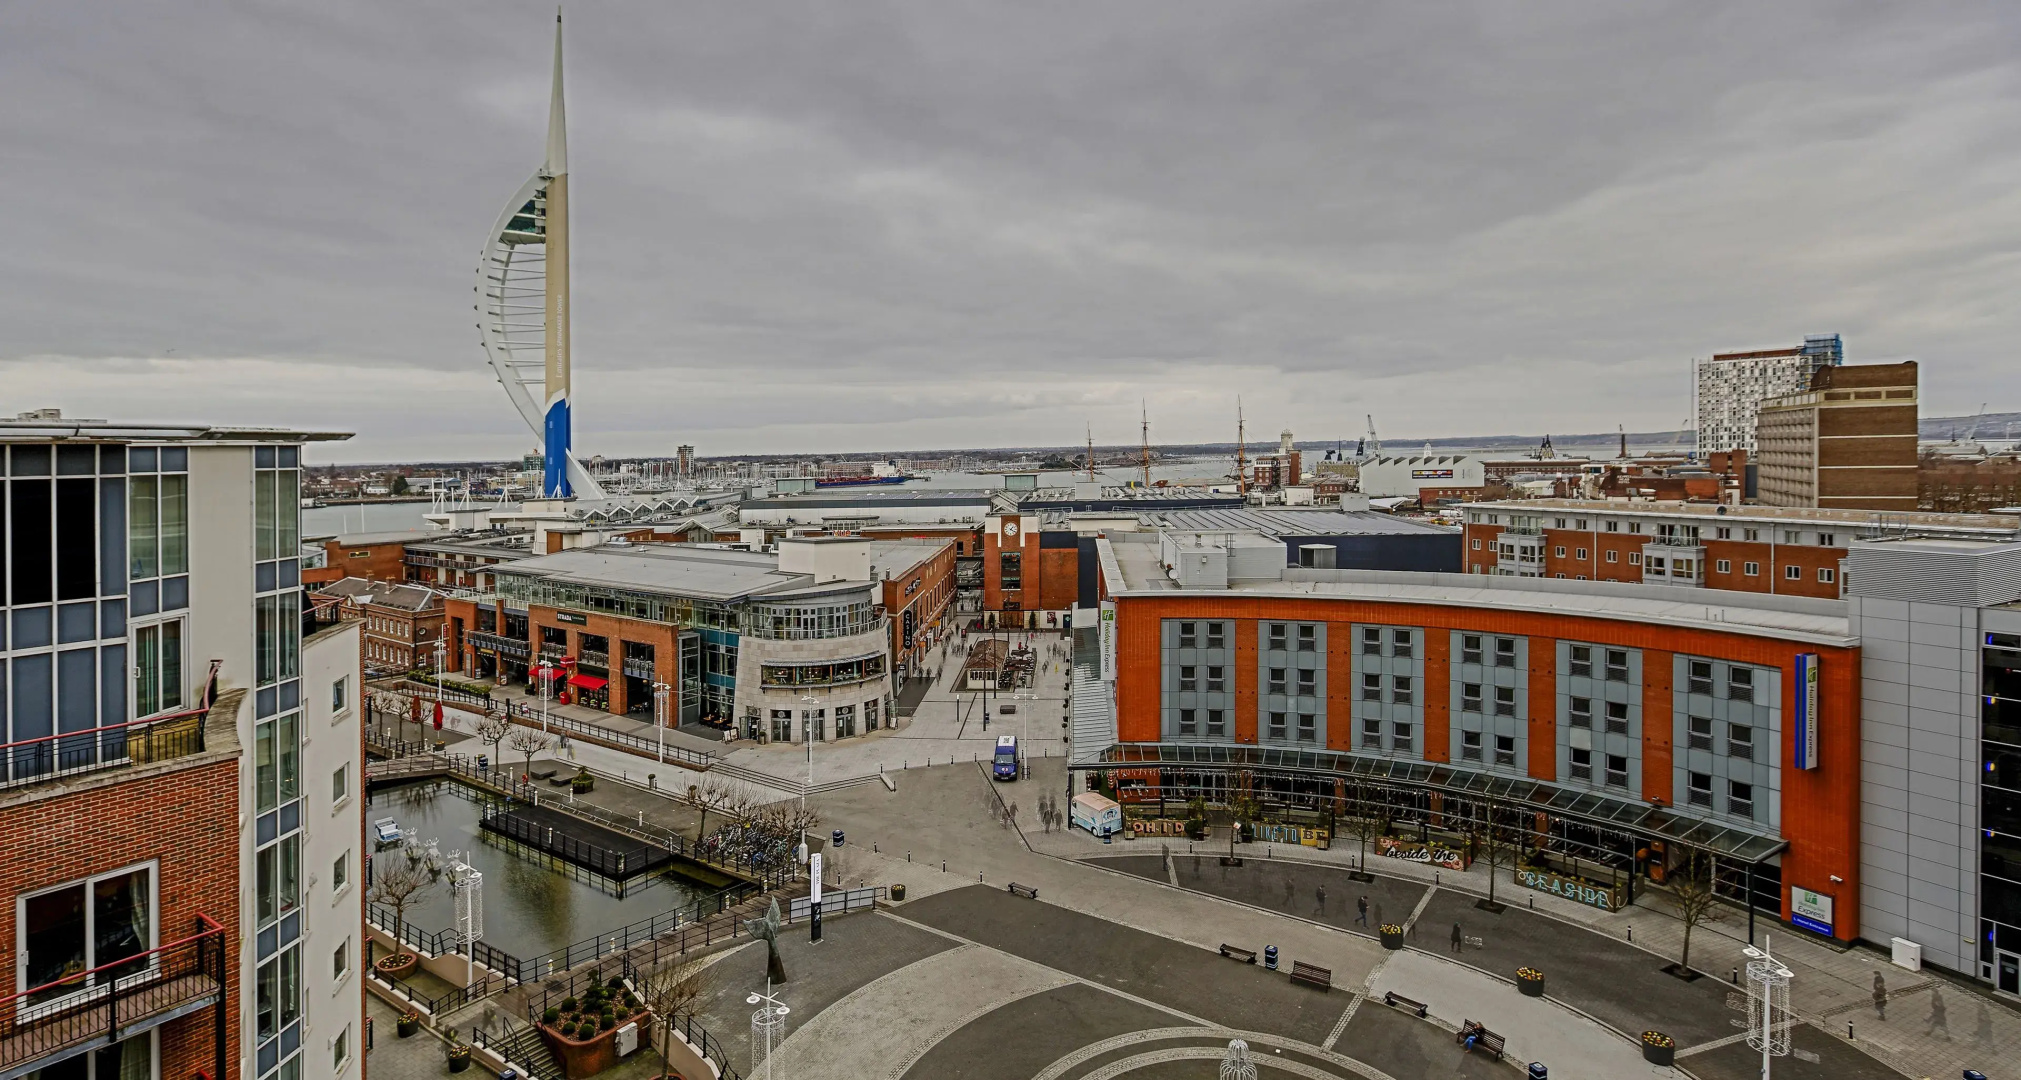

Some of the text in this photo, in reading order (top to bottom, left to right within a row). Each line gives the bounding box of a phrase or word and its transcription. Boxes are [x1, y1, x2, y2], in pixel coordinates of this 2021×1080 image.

[557, 613, 573, 621] STRADA
[1103, 622, 1111, 643] Holiday
[1132, 821, 1156, 833] OH
[1252, 823, 1278, 841] LIKE
[1284, 827, 1297, 841] TO
[1386, 845, 1457, 861] beside the
[1525, 871, 1609, 909] SEASIDE
[1798, 905, 1826, 919] Express
